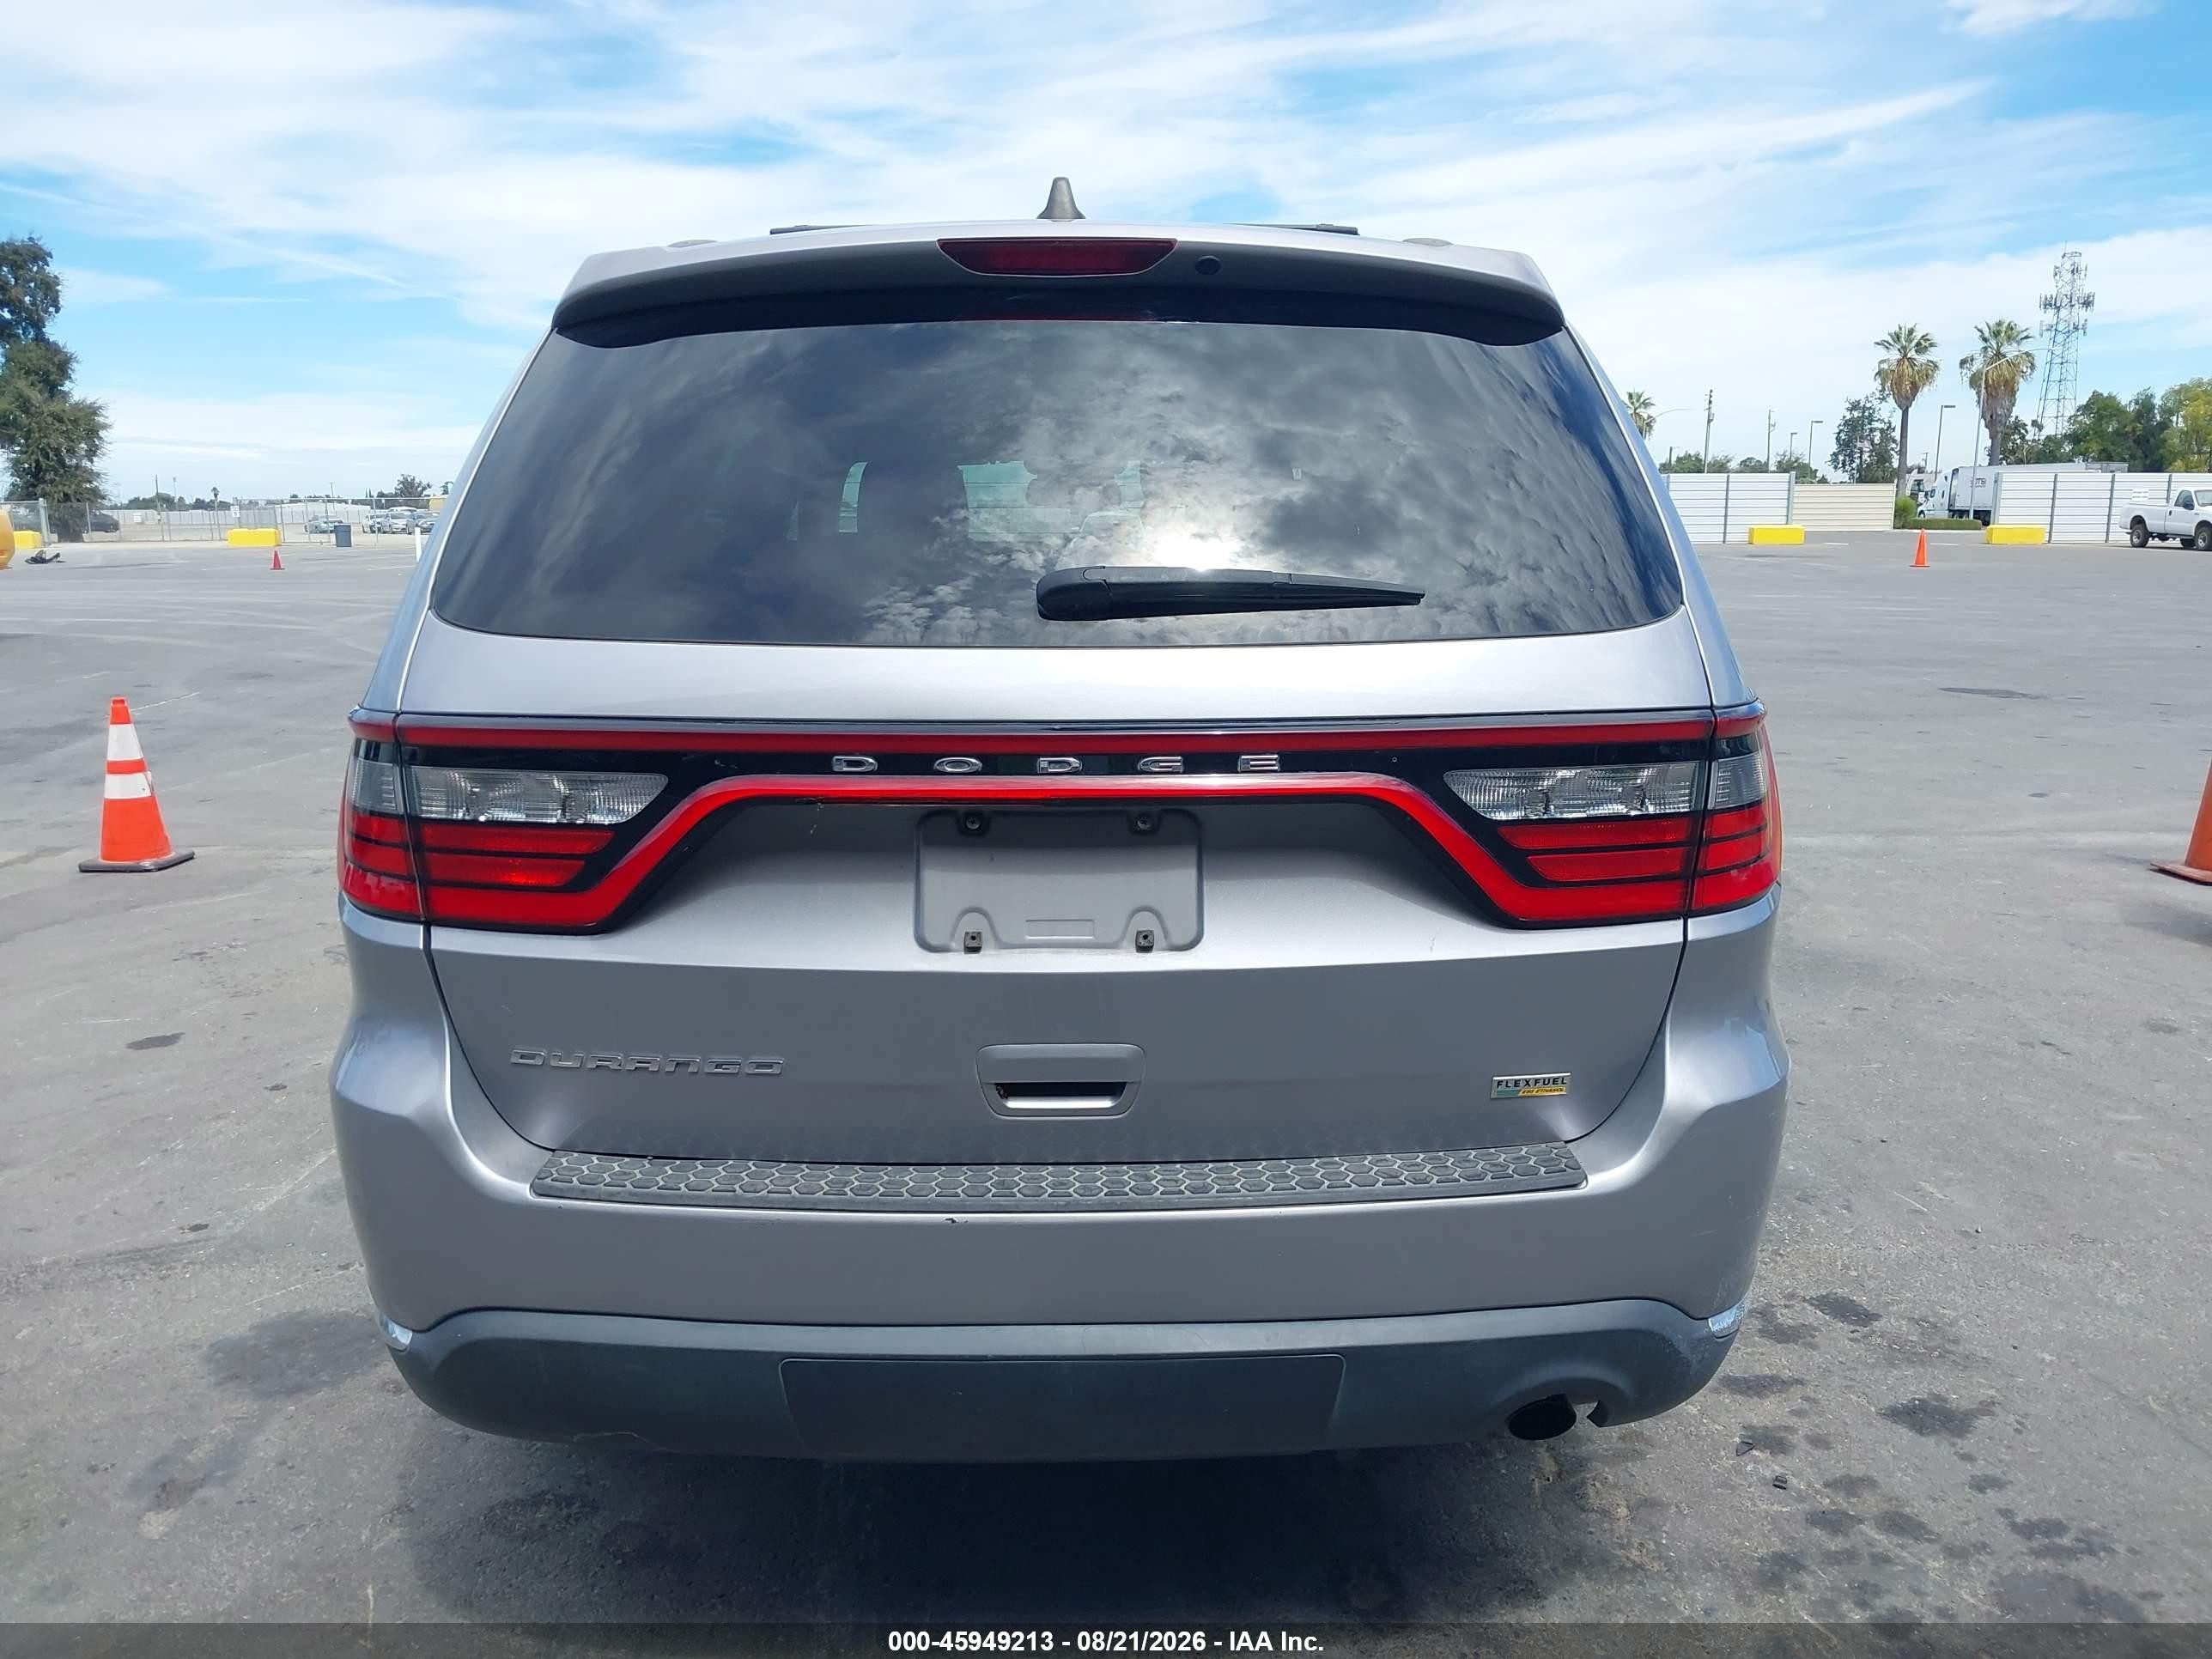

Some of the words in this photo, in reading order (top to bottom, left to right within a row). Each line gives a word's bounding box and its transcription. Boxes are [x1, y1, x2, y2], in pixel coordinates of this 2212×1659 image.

[831, 754, 1280, 773] DODGE
[510, 1049, 785, 1074] DURANGO
[1497, 1078, 1567, 1088] FLEXFUEL
